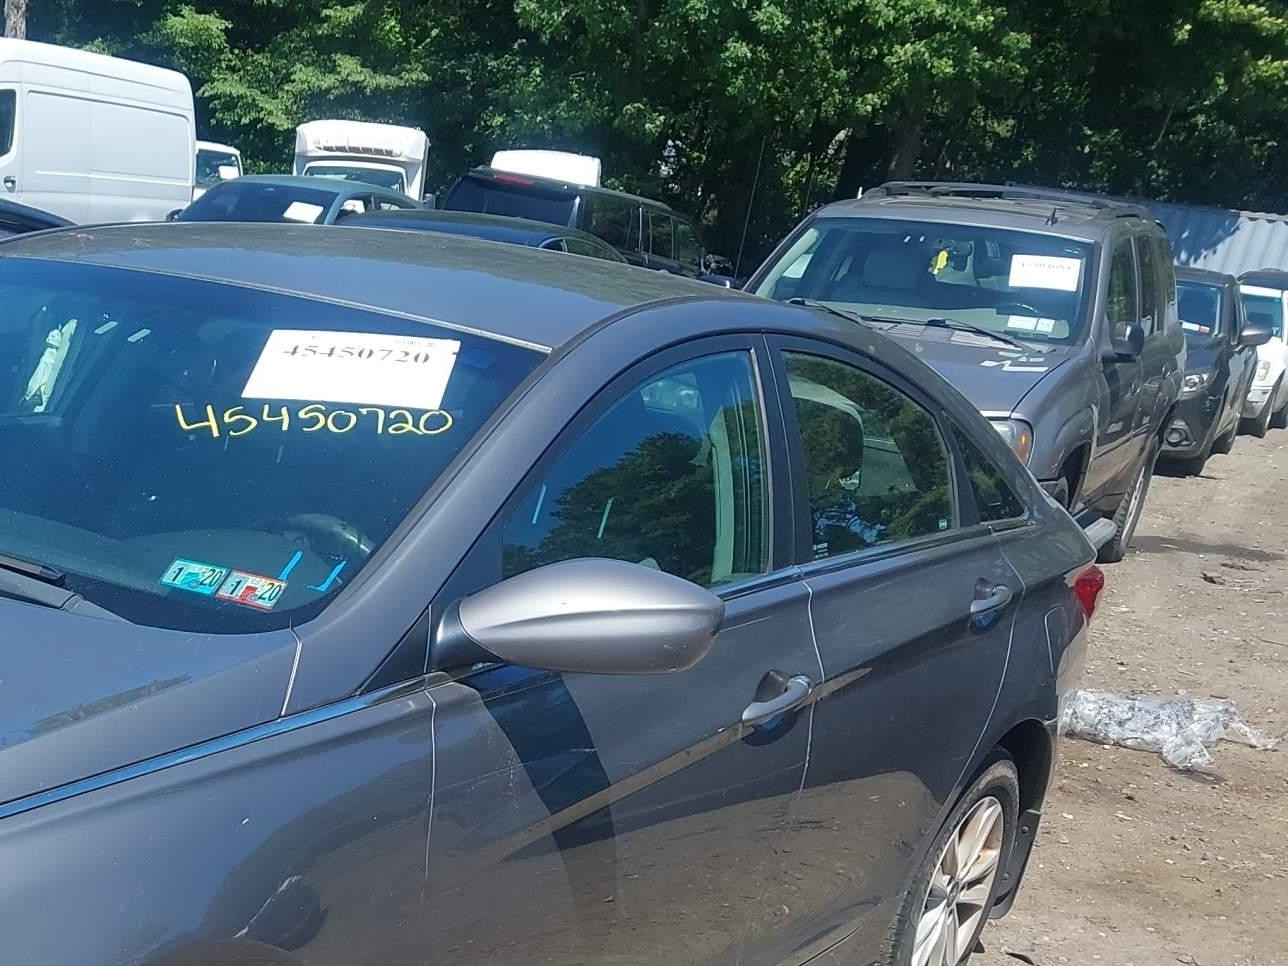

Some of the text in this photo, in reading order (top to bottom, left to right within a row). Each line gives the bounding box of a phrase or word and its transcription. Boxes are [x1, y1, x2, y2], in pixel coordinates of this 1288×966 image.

[282, 344, 431, 364] 45450720
[174, 402, 454, 438] 45450720
[198, 568, 223, 588] 20
[257, 582, 283, 602] 20
